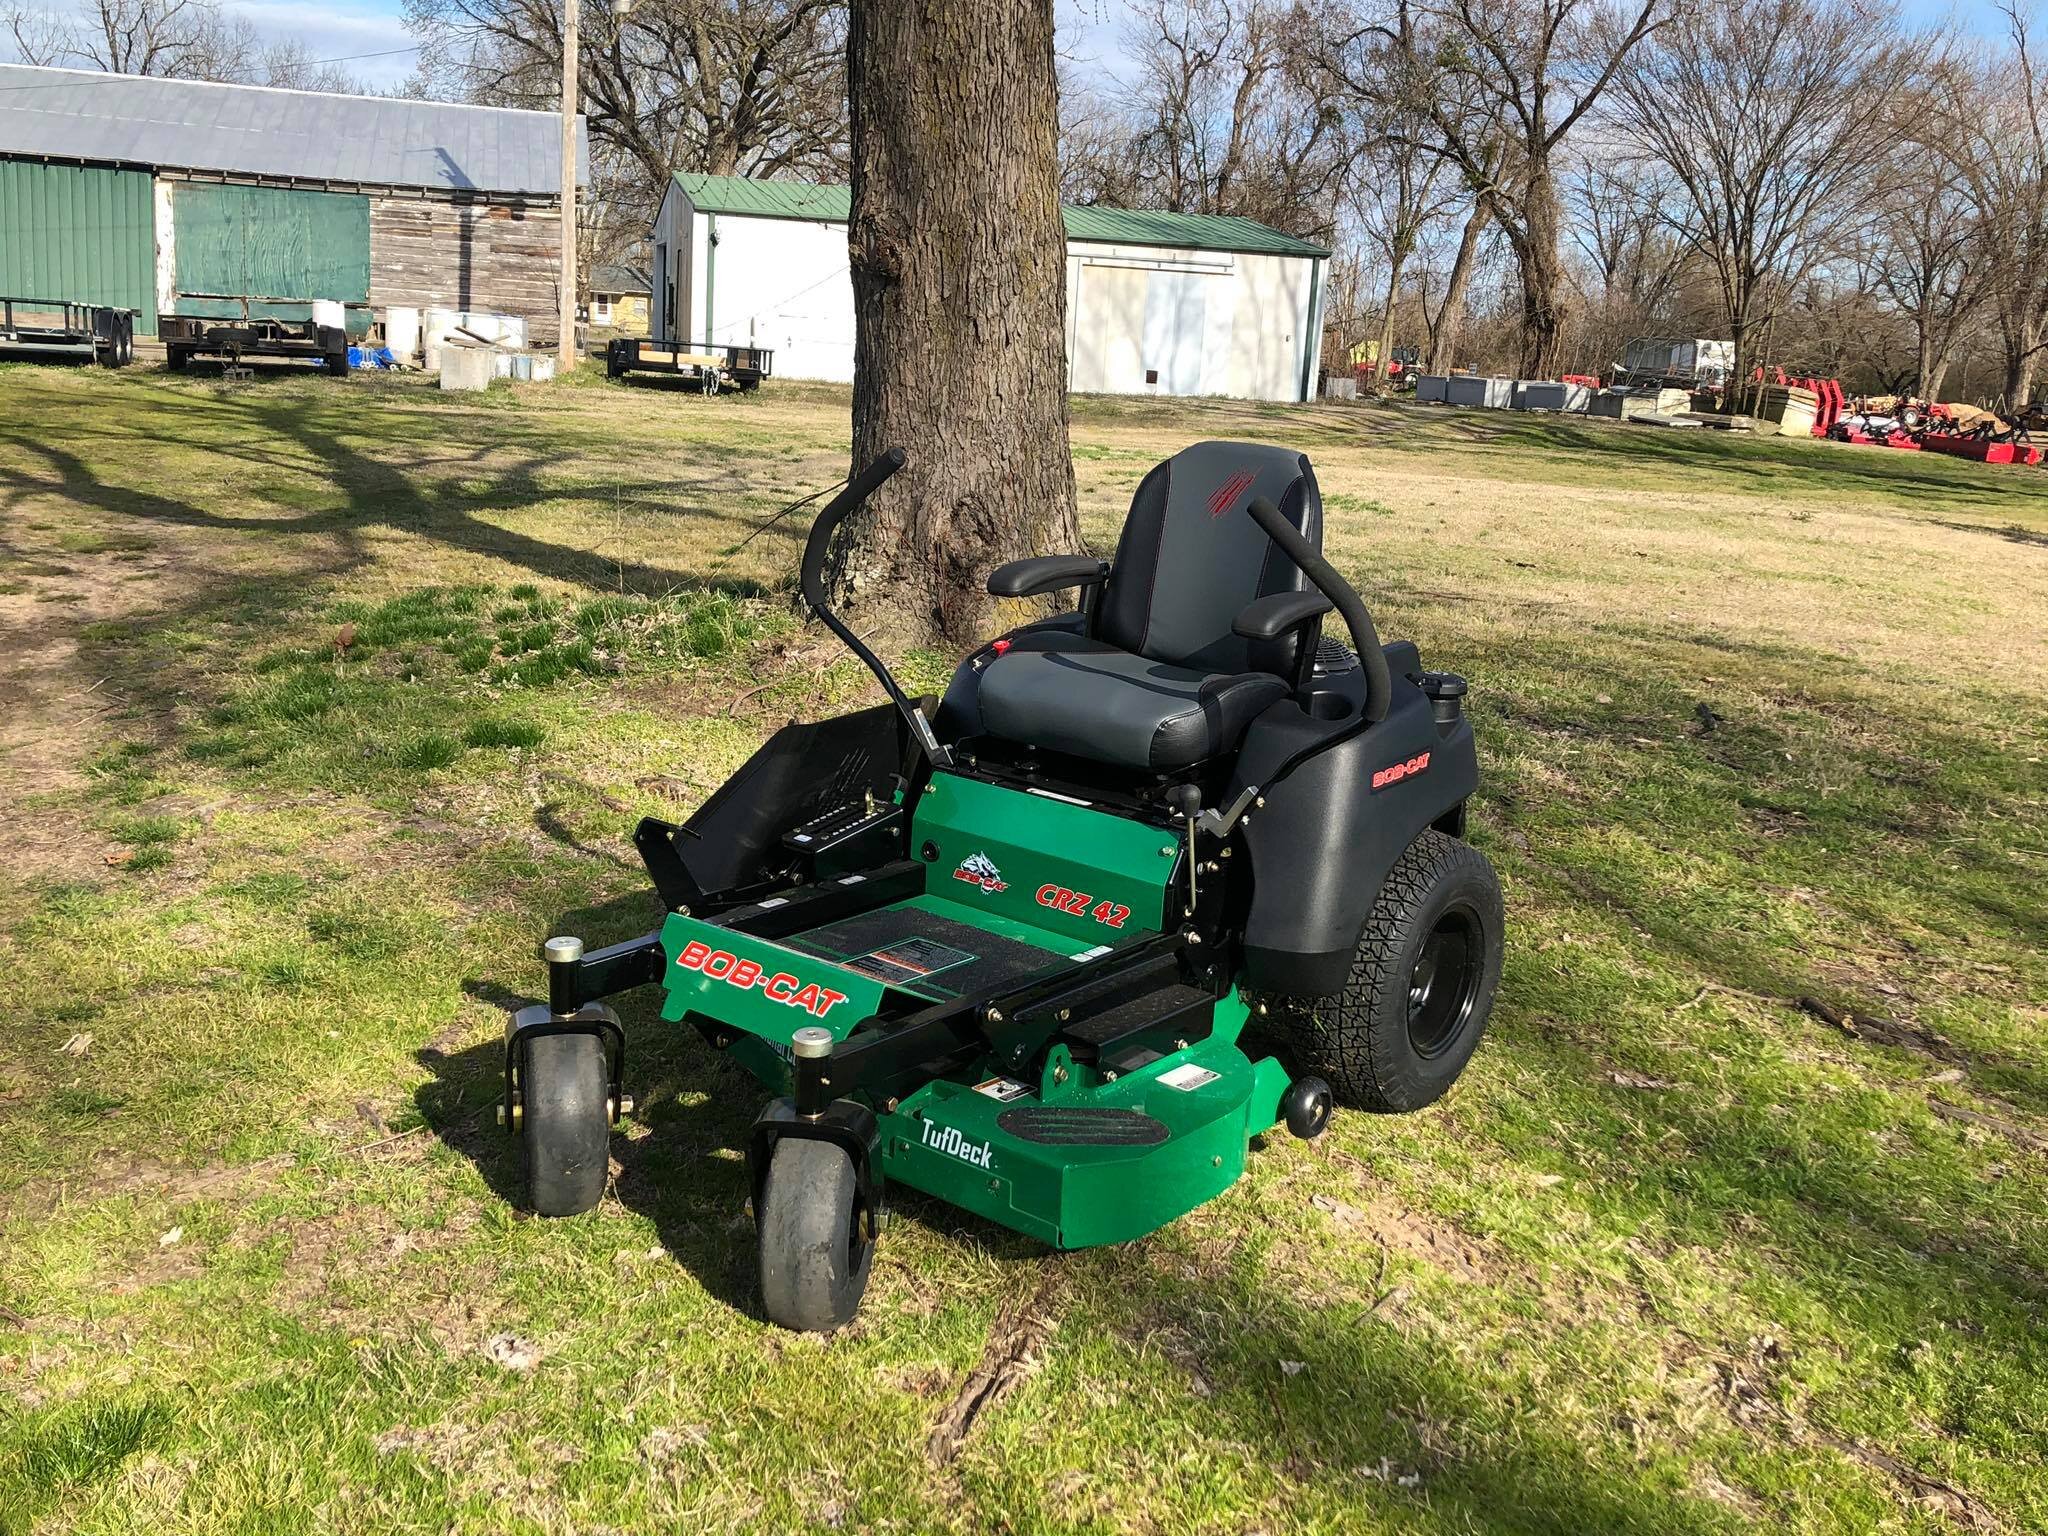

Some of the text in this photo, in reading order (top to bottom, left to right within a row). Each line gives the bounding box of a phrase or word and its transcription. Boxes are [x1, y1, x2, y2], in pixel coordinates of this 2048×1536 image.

[1035, 883, 1131, 929] CRZ 42
[921, 1117, 993, 1170] TufDeck
